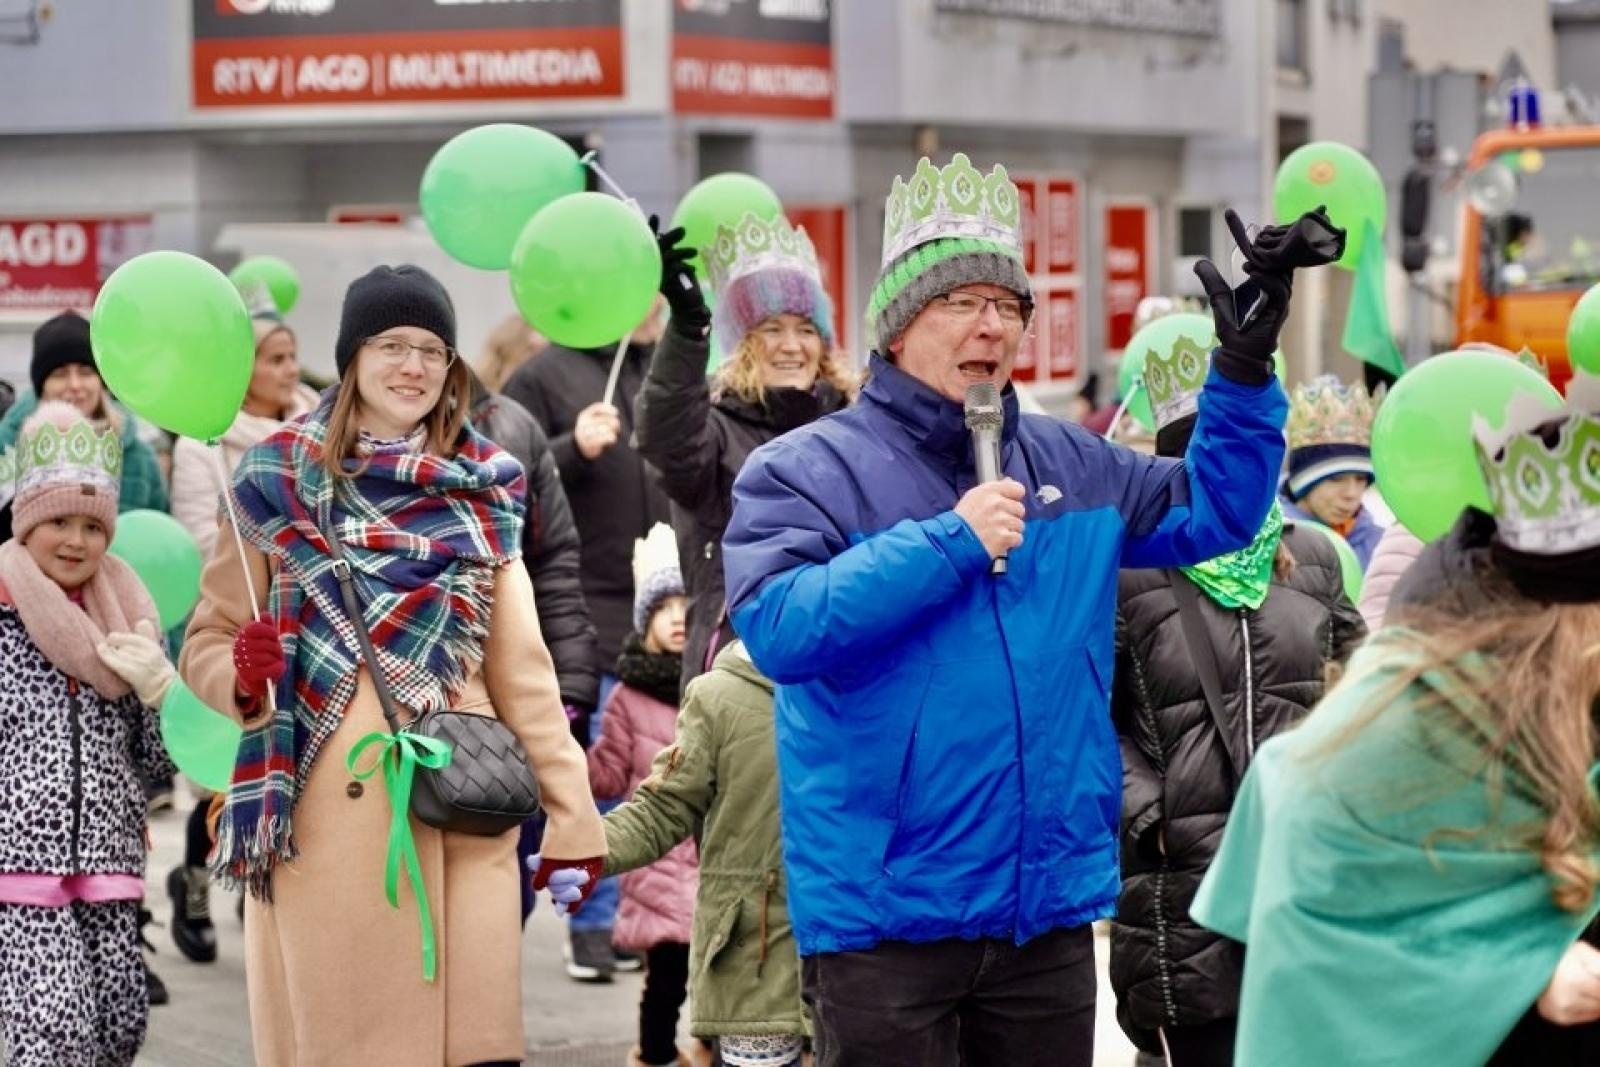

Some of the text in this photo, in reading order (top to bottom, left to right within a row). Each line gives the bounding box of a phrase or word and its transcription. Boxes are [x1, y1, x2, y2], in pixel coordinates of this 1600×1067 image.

[213, 47, 603, 95] RTV AGD MULTIMEDIA
[0, 222, 88, 267] AGD
